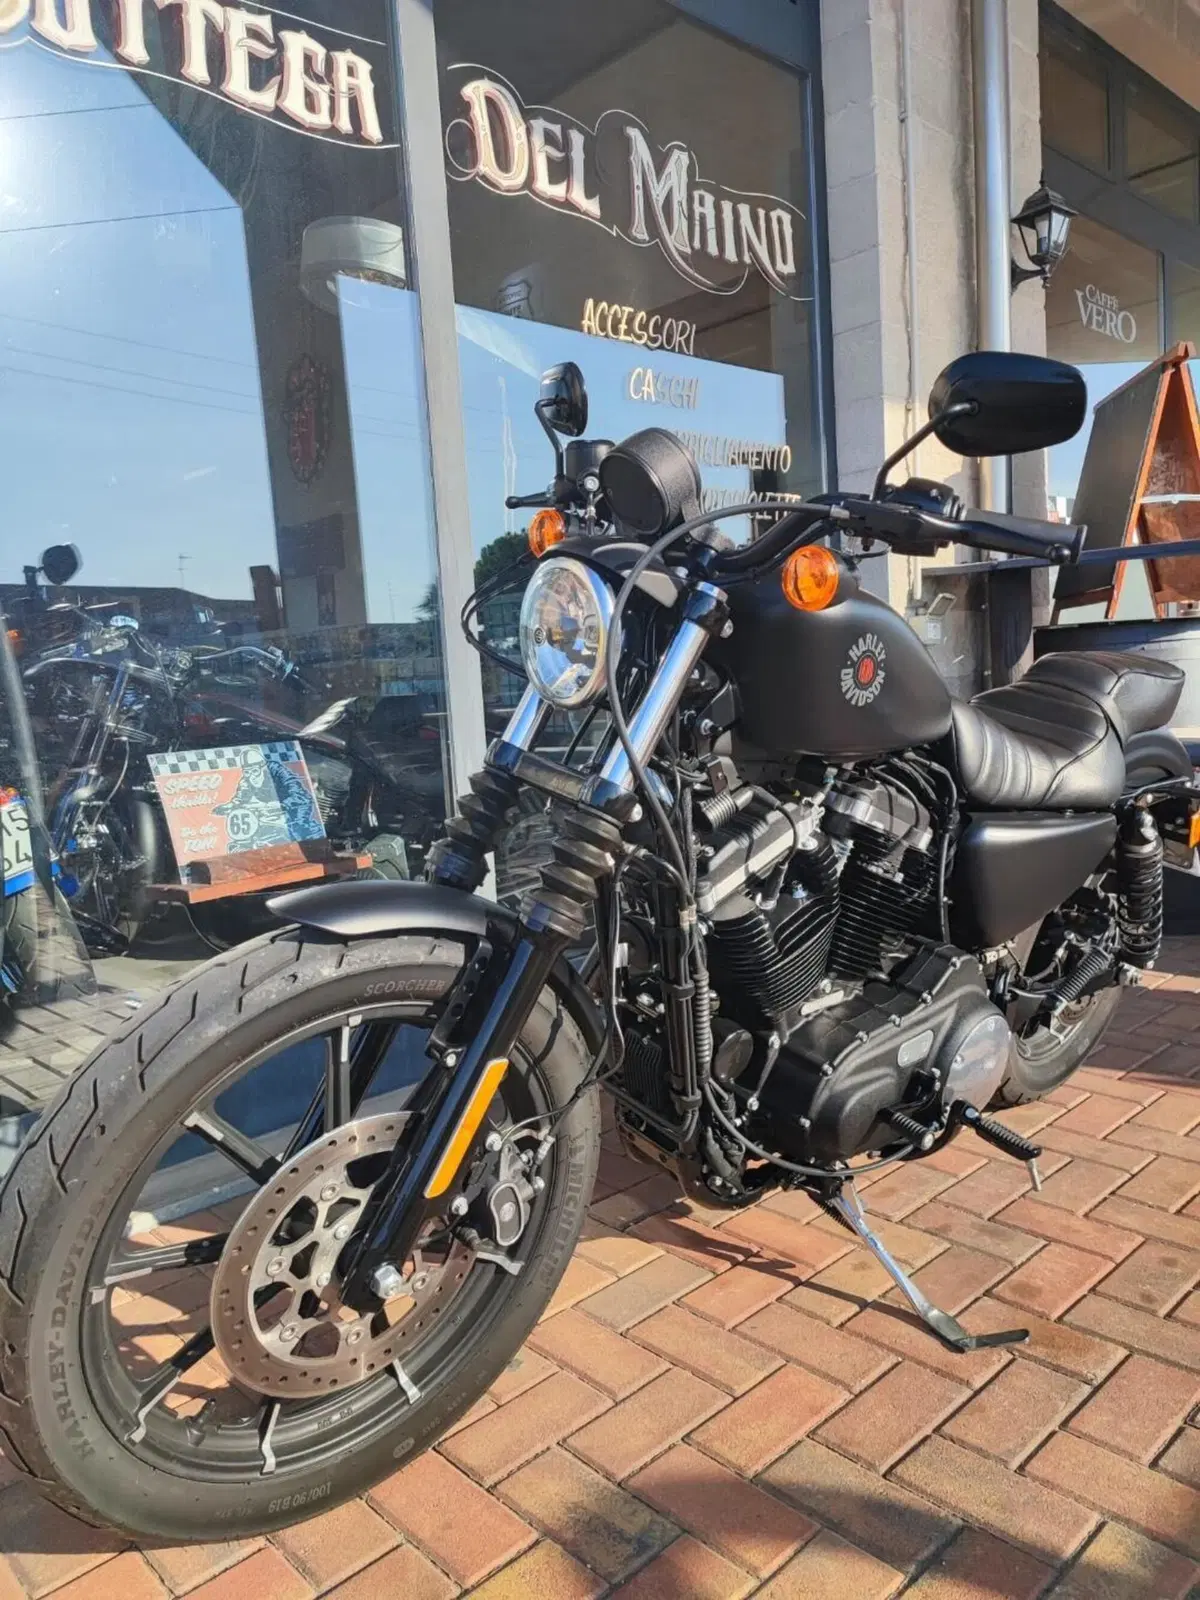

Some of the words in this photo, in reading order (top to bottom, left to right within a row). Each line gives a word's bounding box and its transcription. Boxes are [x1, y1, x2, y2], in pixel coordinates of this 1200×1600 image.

[460, 77, 601, 219] DEL
[623, 126, 797, 290] MAINO
[581, 297, 697, 356] ACCESSORI
[1073, 288, 1137, 343] VERO
[848, 632, 887, 662] HARLEY
[840, 667, 886, 707] DAVIDSON
[229, 812, 251, 838] 65
[363, 979, 447, 997] SCORCHER
